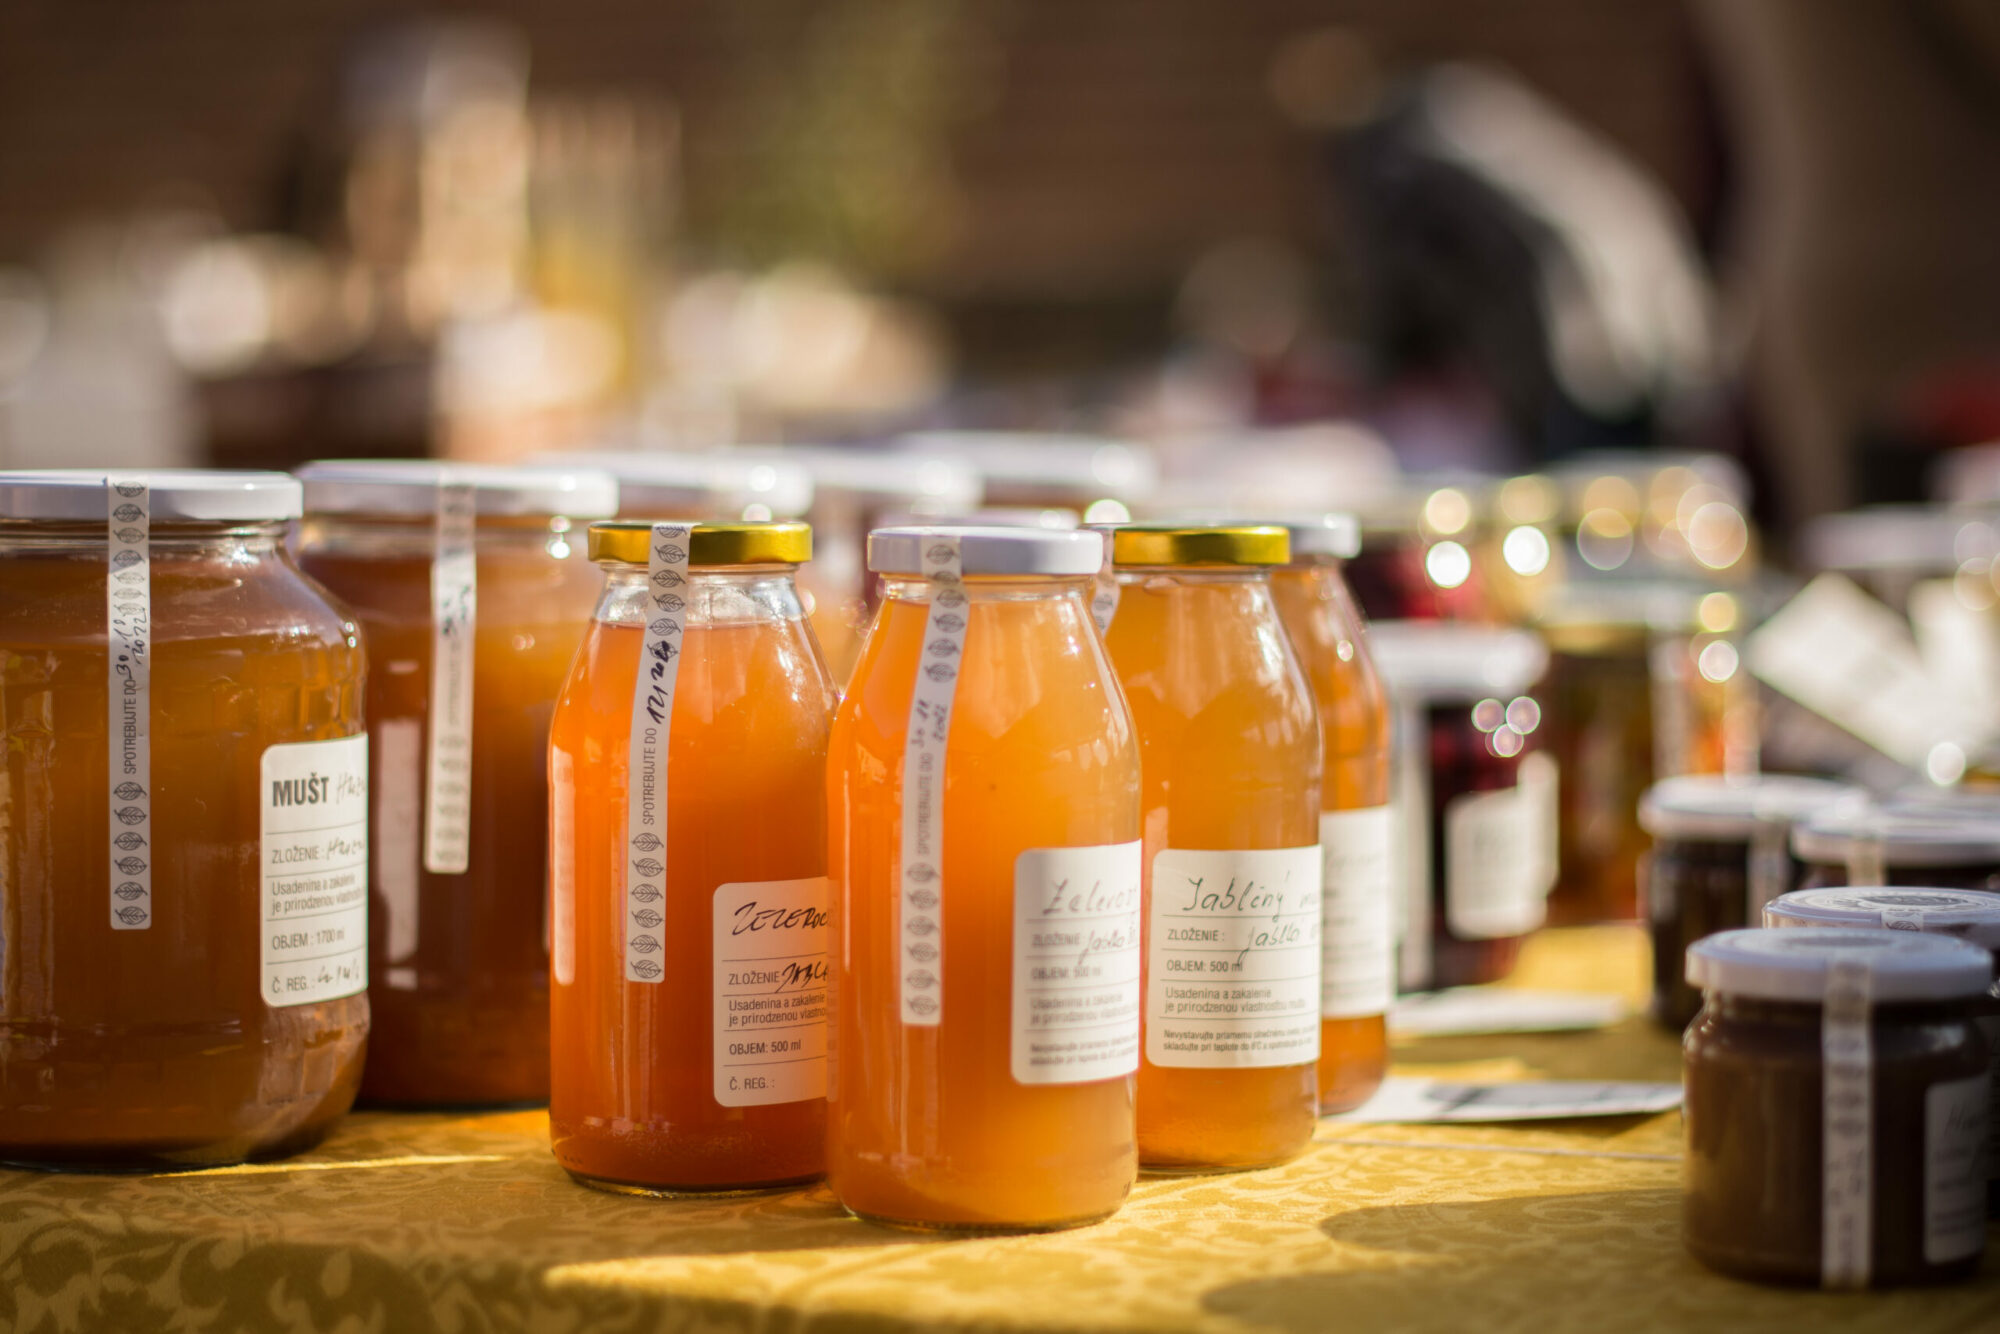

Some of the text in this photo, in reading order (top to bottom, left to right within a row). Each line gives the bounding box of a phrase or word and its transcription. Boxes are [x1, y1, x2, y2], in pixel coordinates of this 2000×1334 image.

[123, 699, 137, 775] SPOTREBUJTE
[642, 728, 657, 826] SPOTREBUJTE DO
[272, 772, 329, 807] MUŠT
[272, 878, 321, 896] Usadenina
[271, 897, 282, 916] je
[1166, 959, 1207, 973] OBJEM:
[1209, 960, 1229, 973] 500
[1165, 986, 1220, 999] Usadenina
[1222, 991, 1229, 999] a
[729, 997, 781, 1012] Usadenina
[784, 999, 790, 1009] a
[1165, 1001, 1174, 1014] je
[1177, 1000, 1239, 1014] prirodzenou
[728, 1013, 739, 1027] je
[741, 1010, 798, 1027] prirodzenou
[729, 1038, 802, 1056] OBJEM: 500 ml
[729, 1076, 741, 1091] Č.
